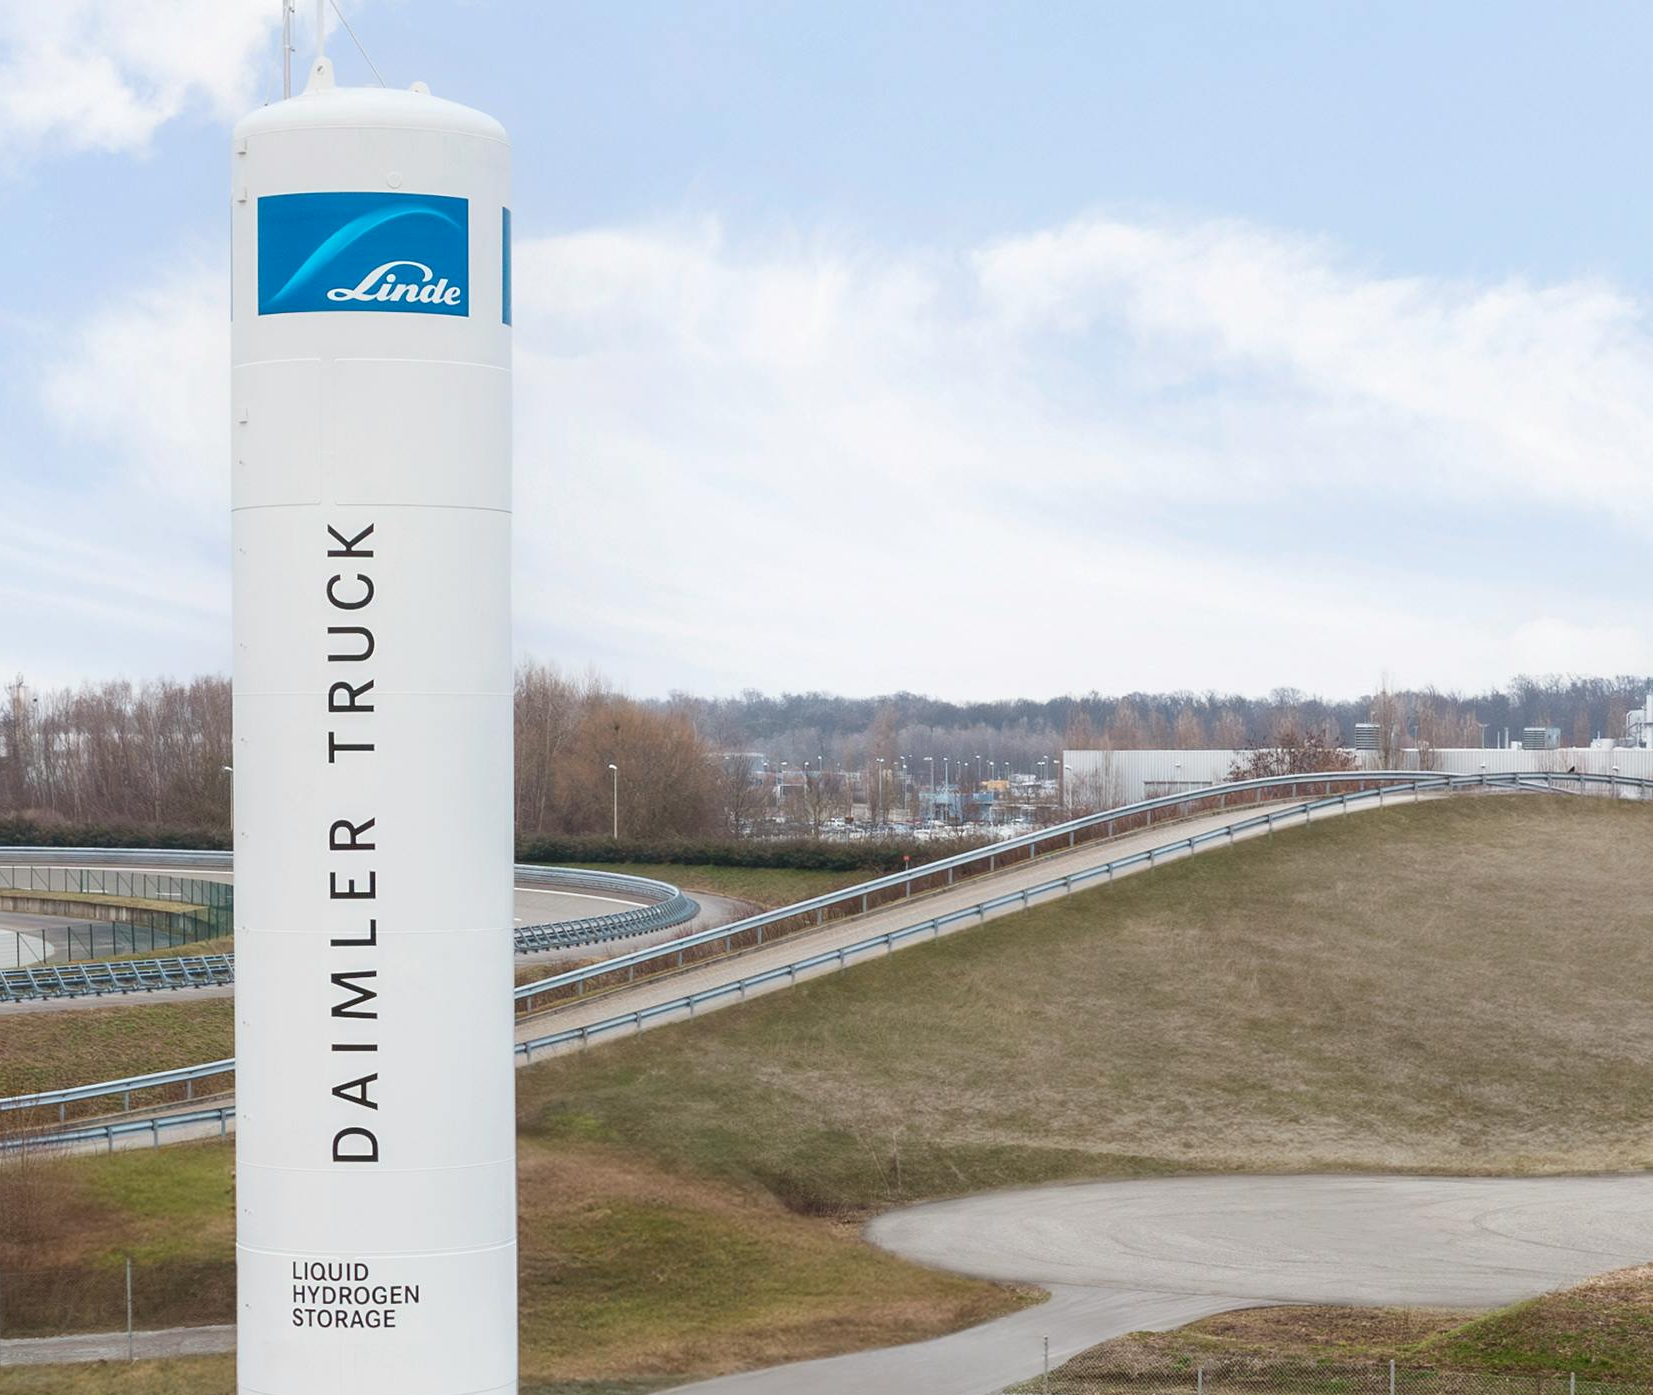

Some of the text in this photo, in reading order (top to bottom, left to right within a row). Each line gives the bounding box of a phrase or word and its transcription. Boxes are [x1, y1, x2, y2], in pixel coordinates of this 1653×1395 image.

[327, 261, 461, 305] Linde
[326, 523, 379, 1163] DAIMLER TRUCK
[292, 1261, 369, 1281] LIQUID
[293, 1285, 419, 1304] HYDROGEN
[292, 1308, 396, 1328] STORAGE
